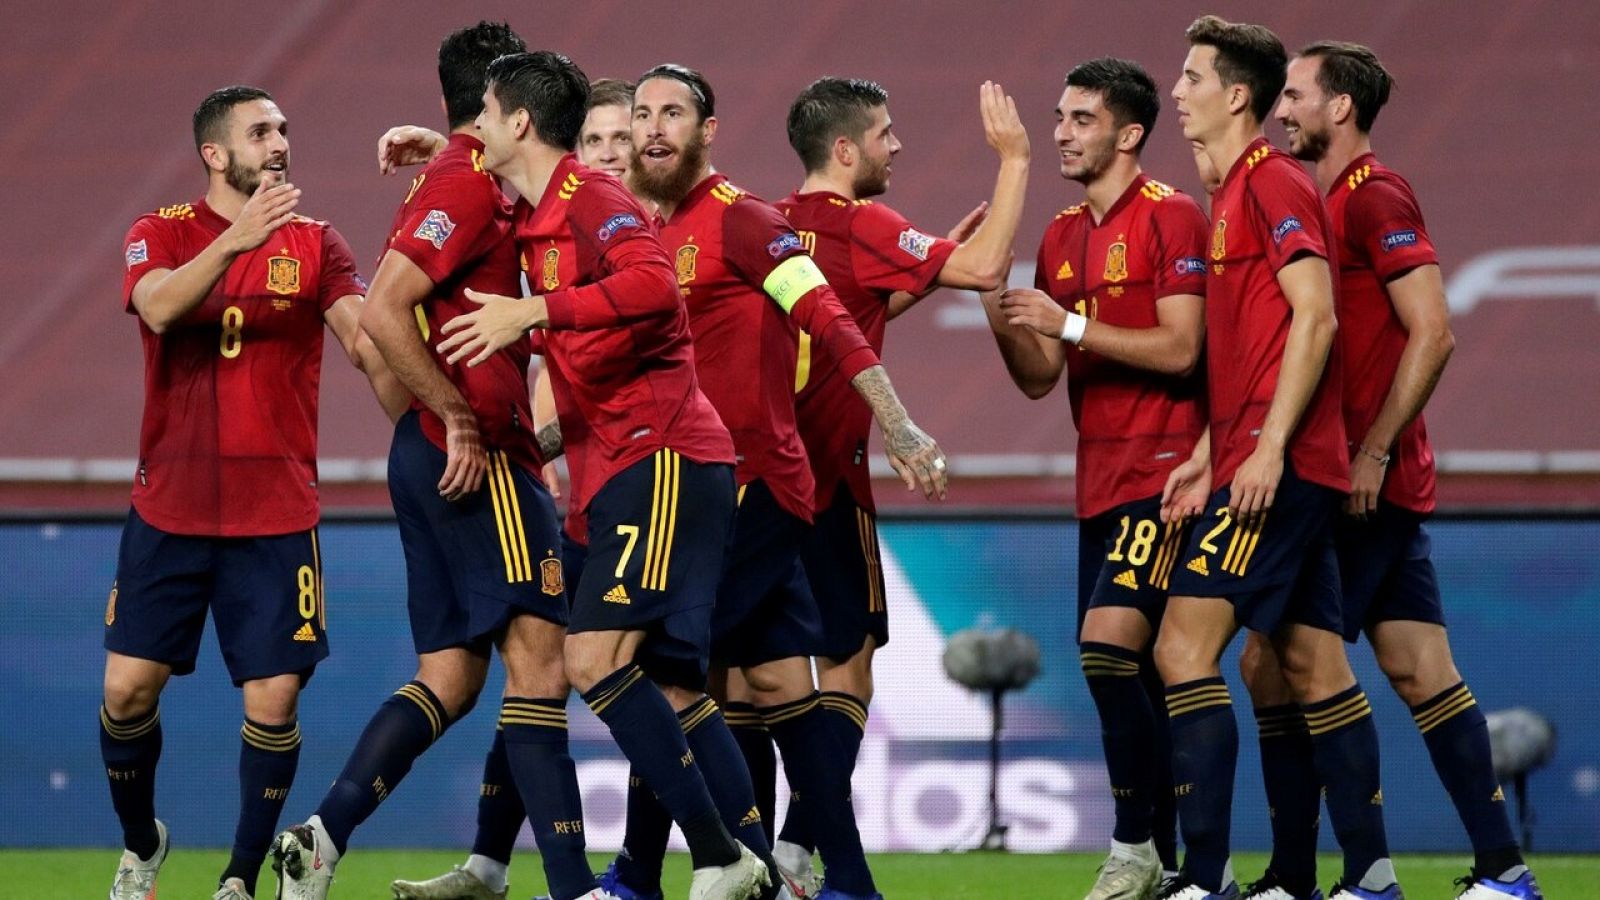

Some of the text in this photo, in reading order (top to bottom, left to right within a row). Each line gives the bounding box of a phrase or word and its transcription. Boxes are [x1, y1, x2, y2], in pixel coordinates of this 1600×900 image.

[221, 305, 244, 359] 8
[614, 524, 639, 578] 7
[1107, 515, 1157, 566] 18
[1200, 506, 1232, 555] 2
[297, 565, 316, 619] 8
[293, 634, 317, 642] adidas
